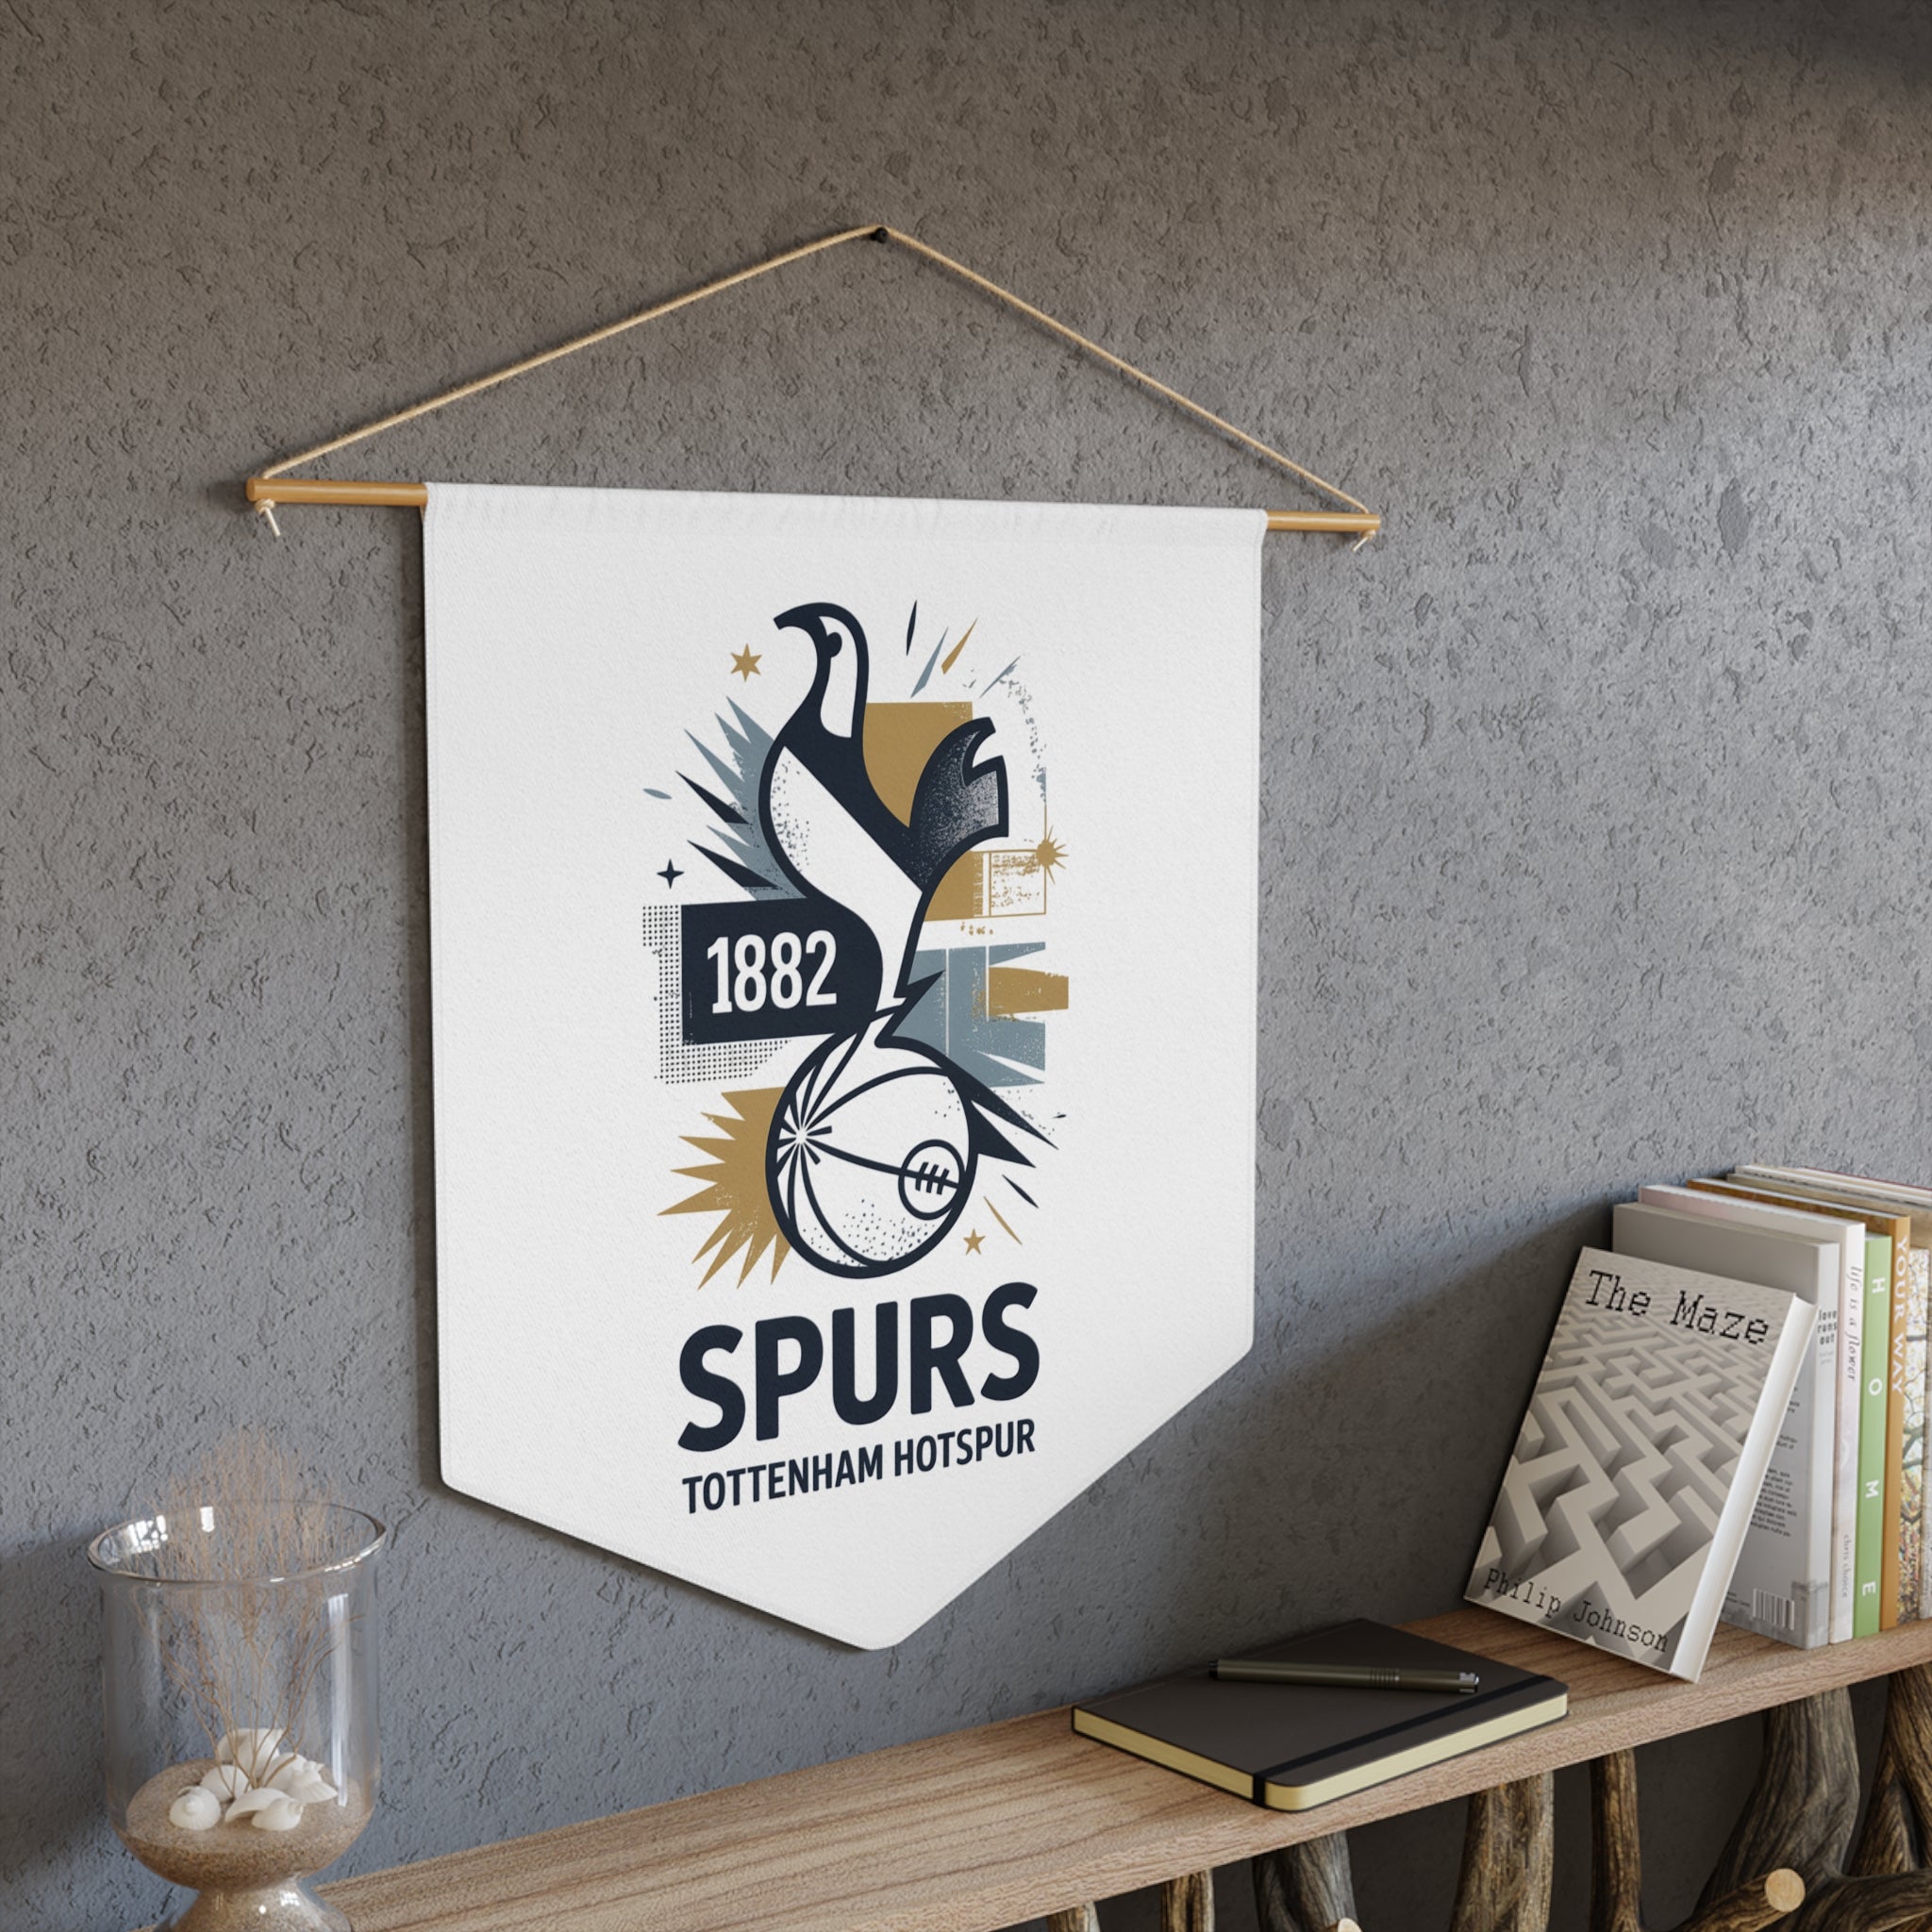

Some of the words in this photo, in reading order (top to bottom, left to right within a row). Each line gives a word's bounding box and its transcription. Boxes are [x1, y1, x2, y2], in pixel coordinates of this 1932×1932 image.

[707, 929, 838, 1014] 1882
[1585, 1270, 1651, 1316] The
[1670, 1290, 1770, 1344] Maze
[1846, 1265, 1862, 1291] life
[1848, 1298, 1861, 1311] is
[1893, 1237, 1907, 1324] YOUR
[1817, 1322, 1838, 1334] runs
[1819, 1333, 1835, 1345] out
[1845, 1330, 1860, 1382] flower
[677, 1281, 1041, 1453] SPURS
[1892, 1332, 1905, 1393] WAY
[681, 1443, 883, 1514] TOTTENHAM
[894, 1418, 1037, 1477] HOTSPUR
[1483, 1568, 1561, 1619] Philip
[1574, 1600, 1669, 1653] Johnson
